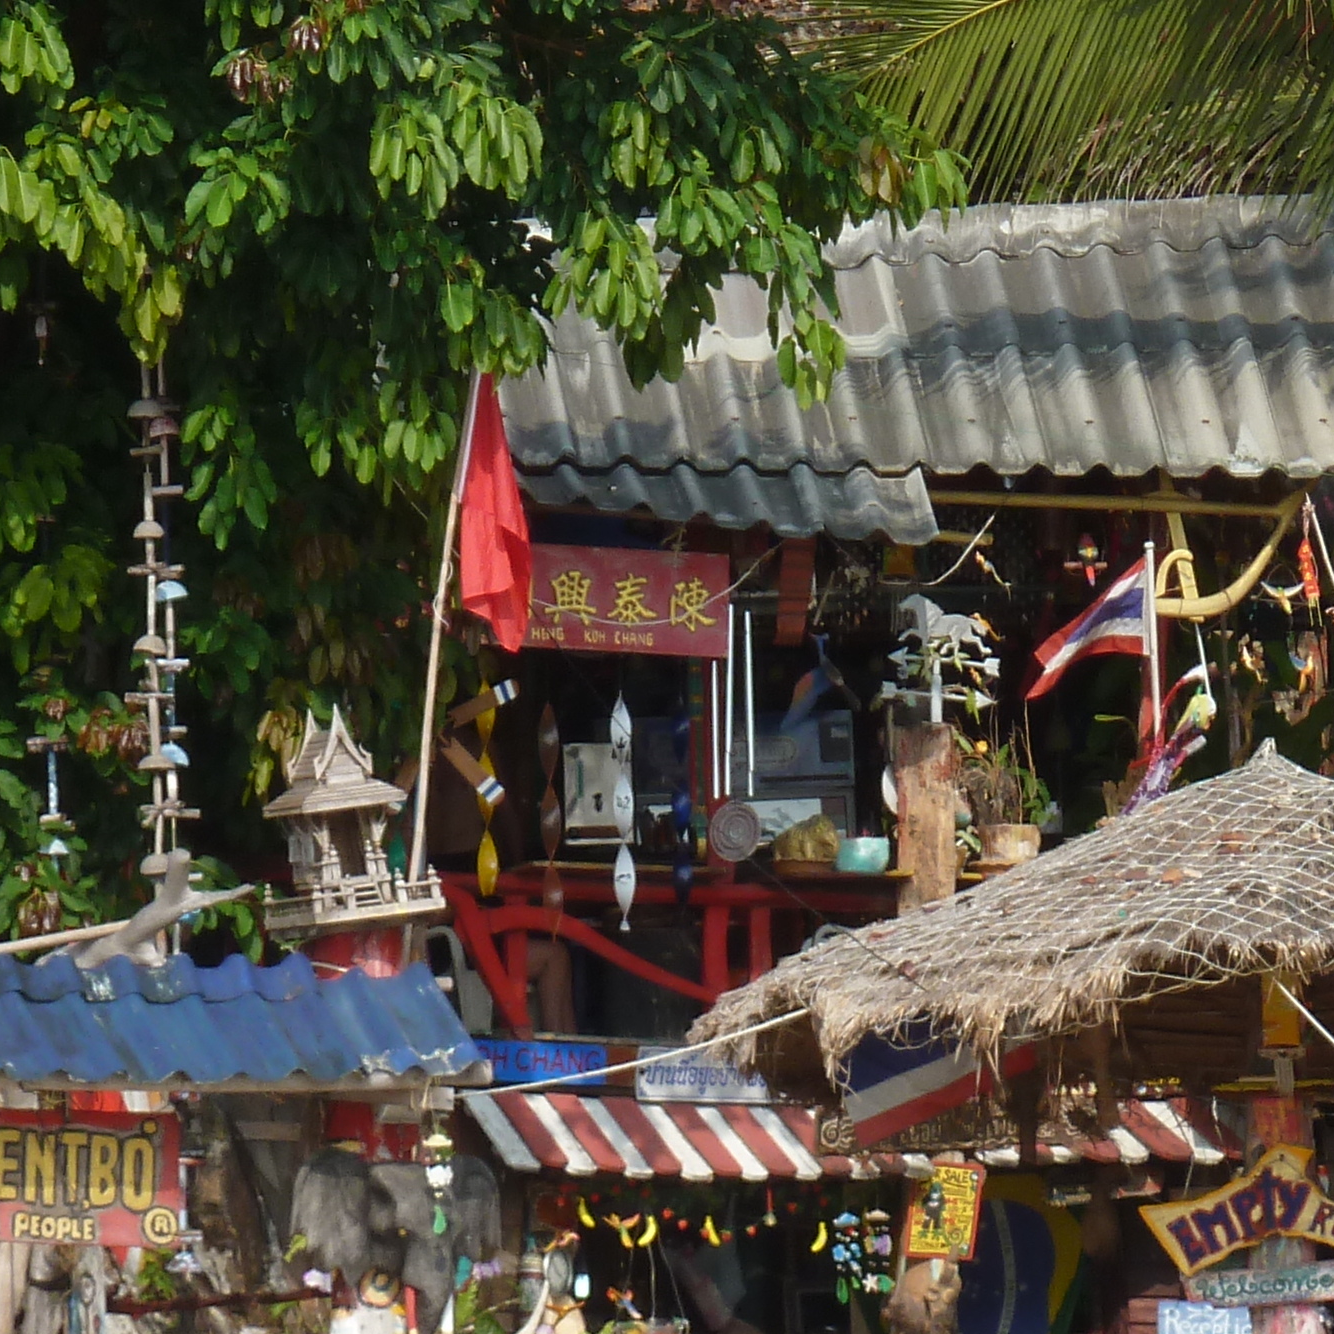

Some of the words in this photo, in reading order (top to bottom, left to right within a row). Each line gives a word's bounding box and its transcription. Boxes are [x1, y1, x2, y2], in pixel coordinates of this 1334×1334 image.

[613, 630, 655, 647] CHANG
[515, 1047, 602, 1073] CHANG
[14, 1211, 95, 1242] PEOPLE
